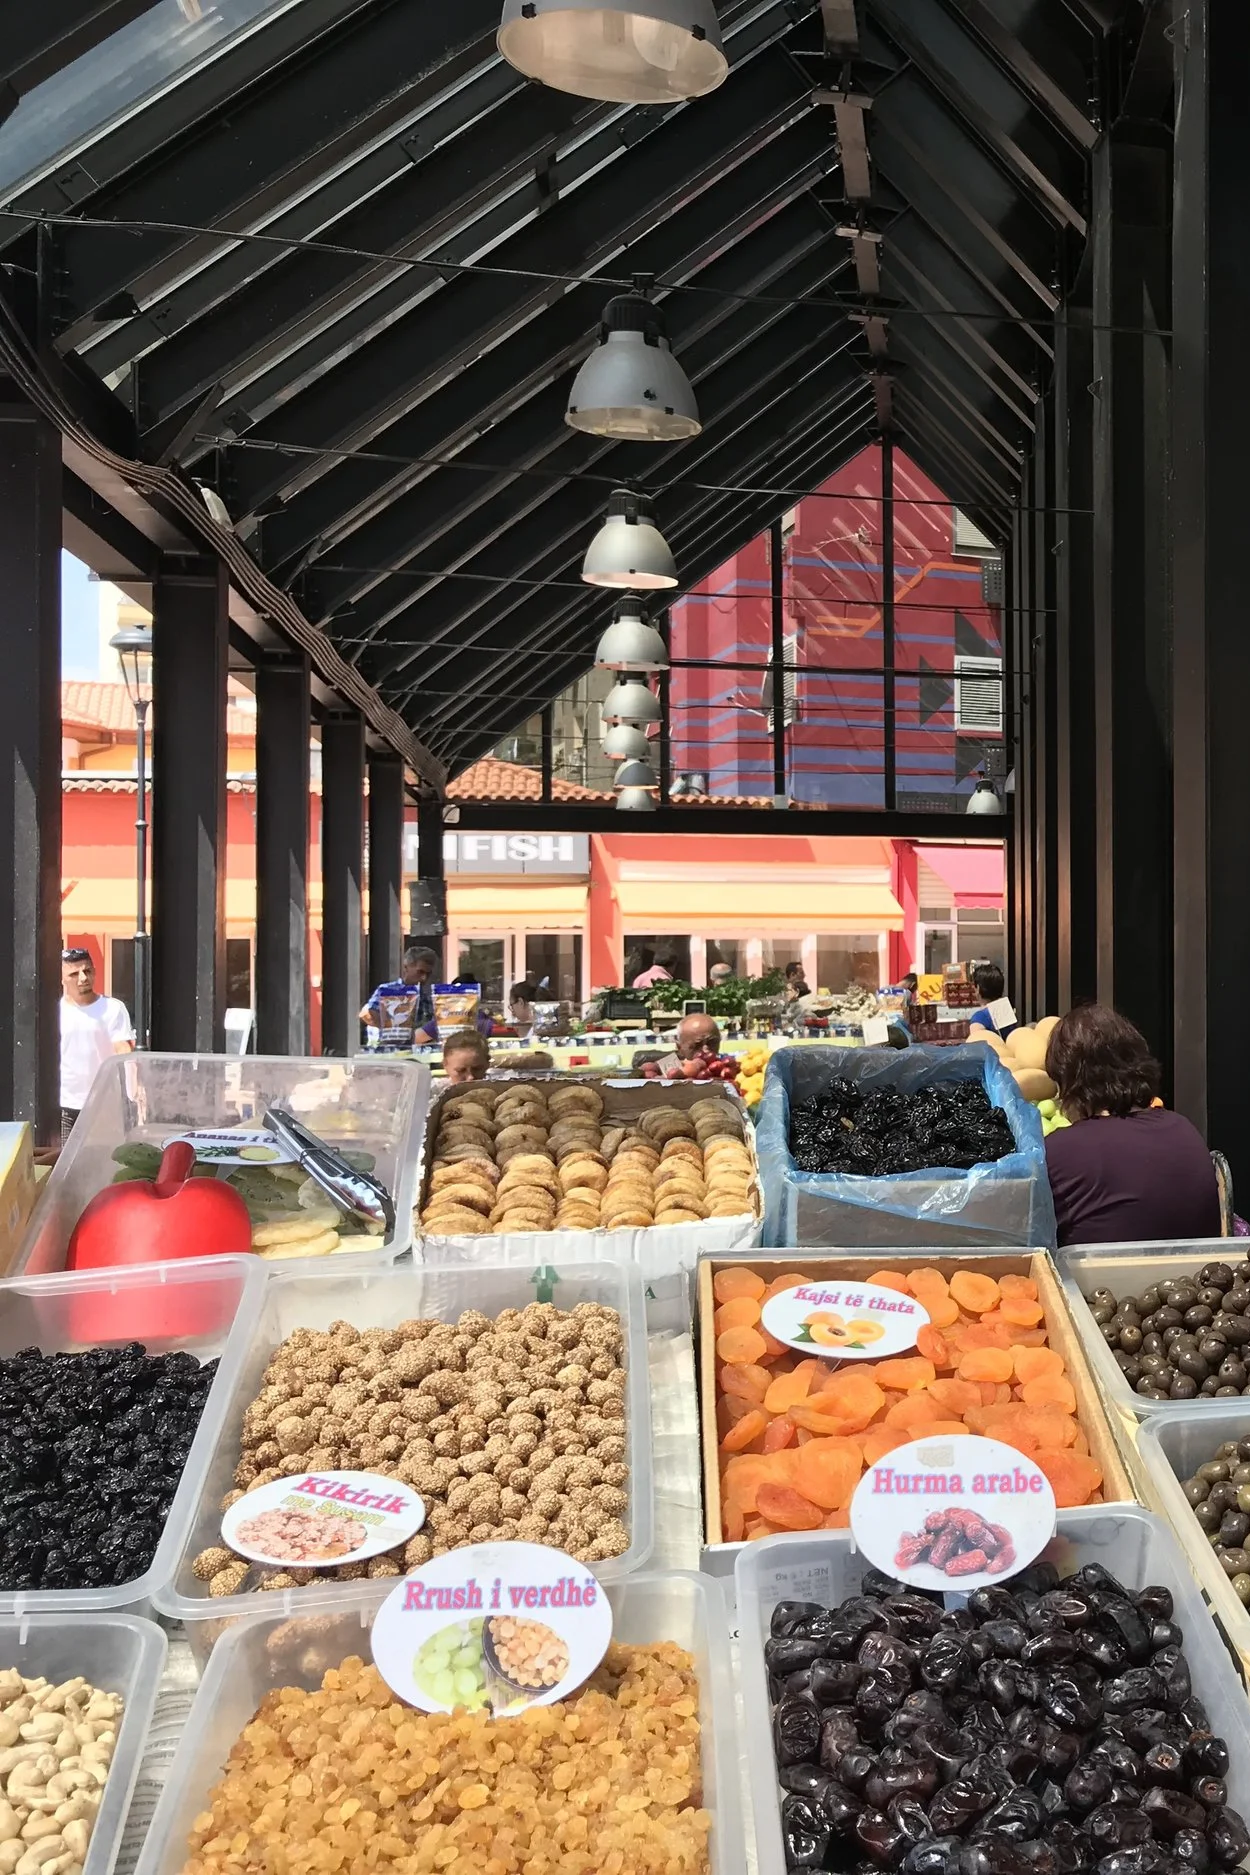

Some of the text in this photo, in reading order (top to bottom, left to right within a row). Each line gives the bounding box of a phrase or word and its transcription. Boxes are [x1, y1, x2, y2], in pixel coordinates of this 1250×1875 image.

[462, 835, 574, 861] FISH
[793, 1287, 915, 1315] Kajsi të thata
[291, 1476, 410, 1514] Kikirik
[872, 1467, 1043, 1495] Hurma arabe
[280, 1494, 386, 1526] me Susam
[402, 1577, 598, 1611] Rrush i verdhë
